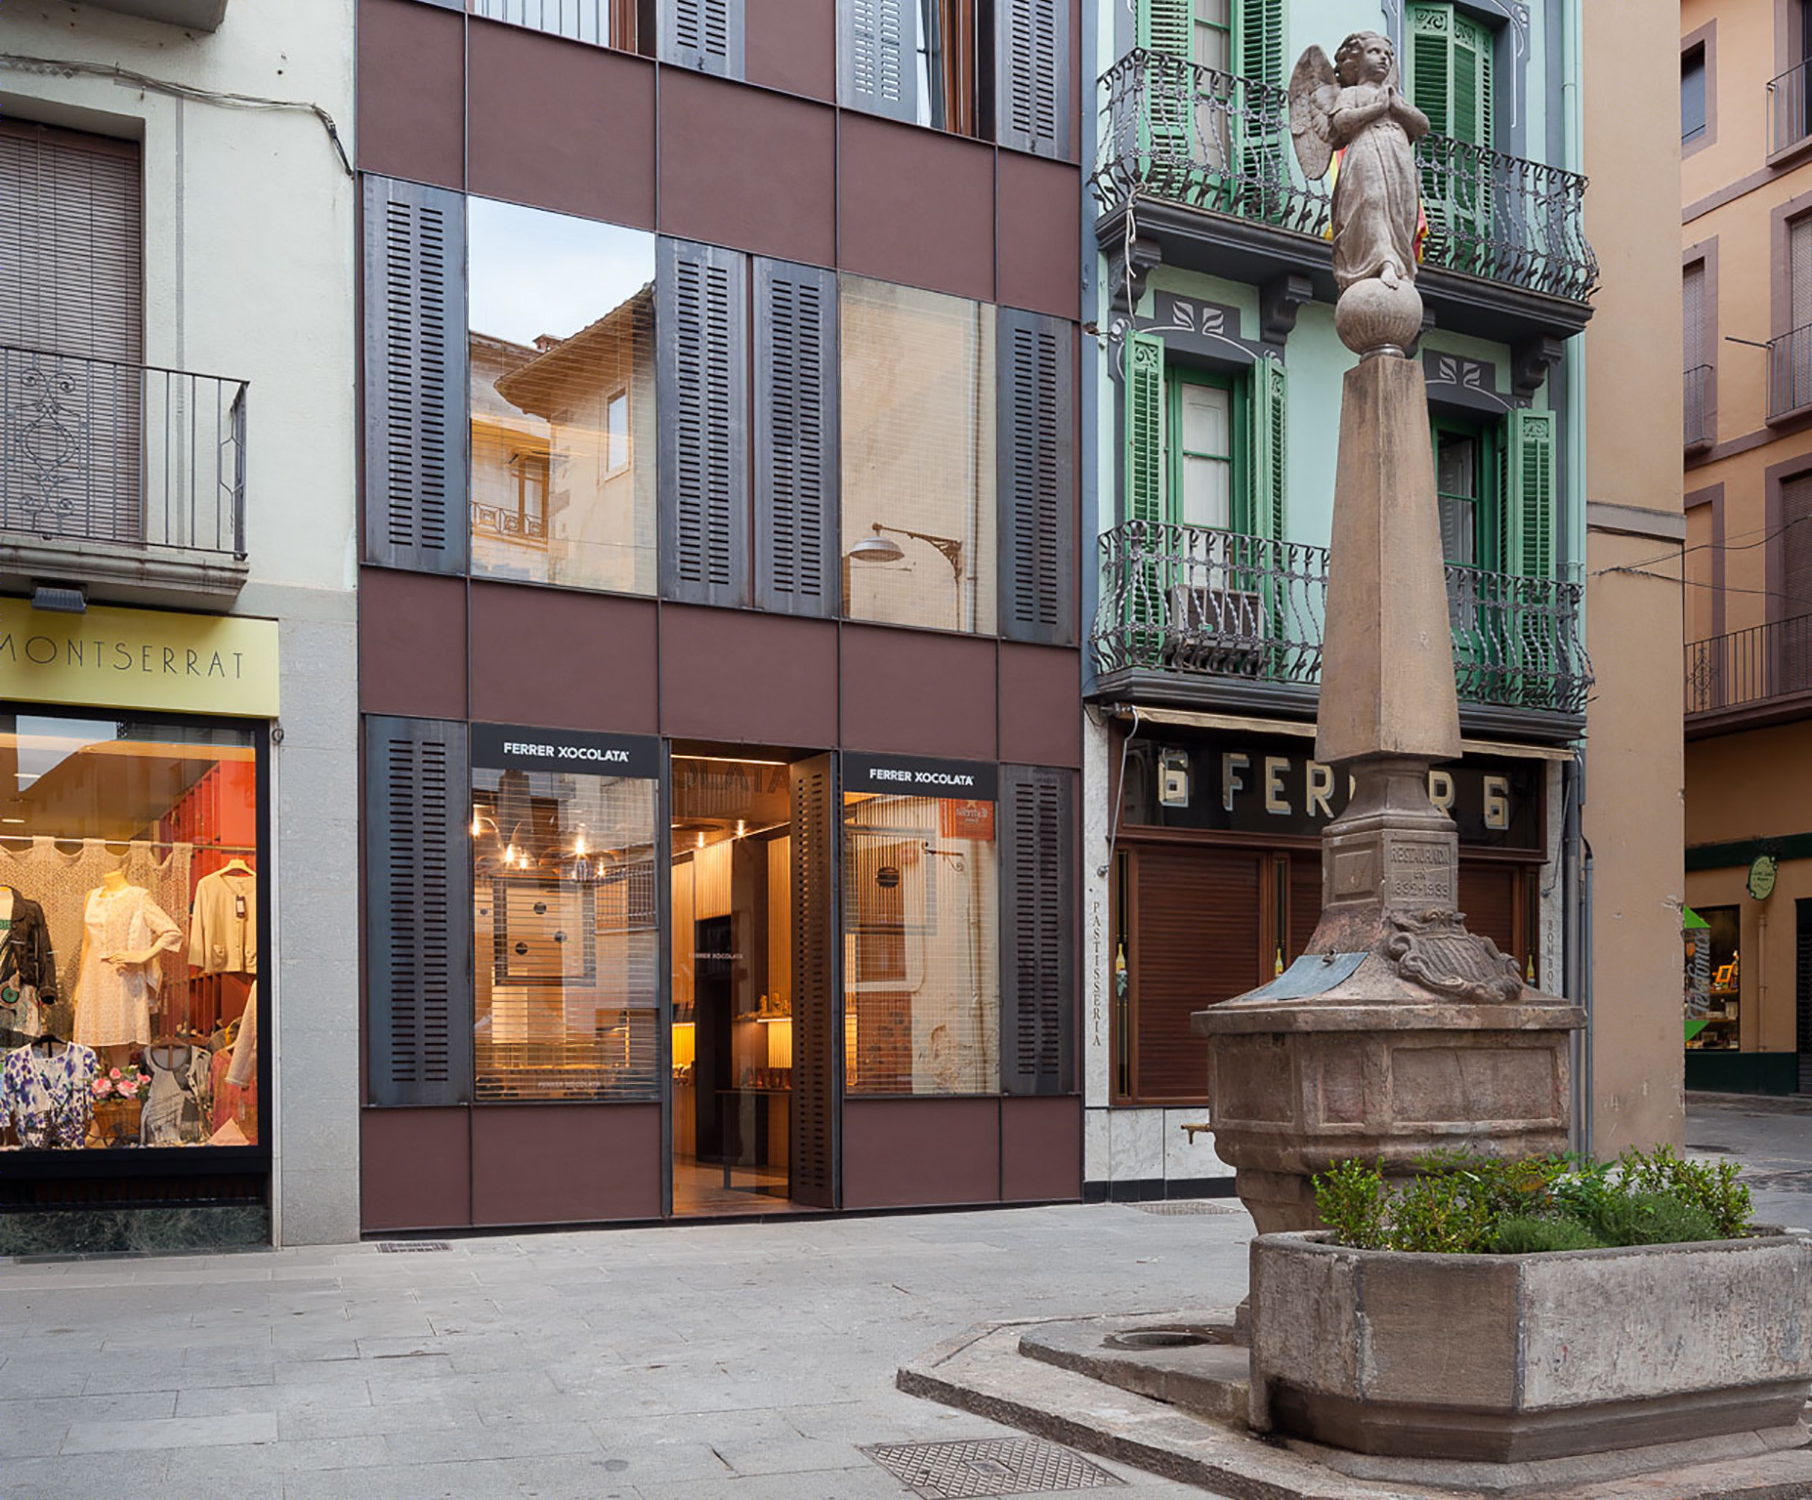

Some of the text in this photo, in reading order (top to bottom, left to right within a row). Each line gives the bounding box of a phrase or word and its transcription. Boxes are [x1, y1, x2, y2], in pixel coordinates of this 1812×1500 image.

[503, 741, 629, 762] FERRER XOCOLATA
[869, 768, 974, 786] FERRER XOCOLATA
[1222, 751, 1455, 819] FERR
[1092, 901, 1101, 1046] PASTISSERIA
